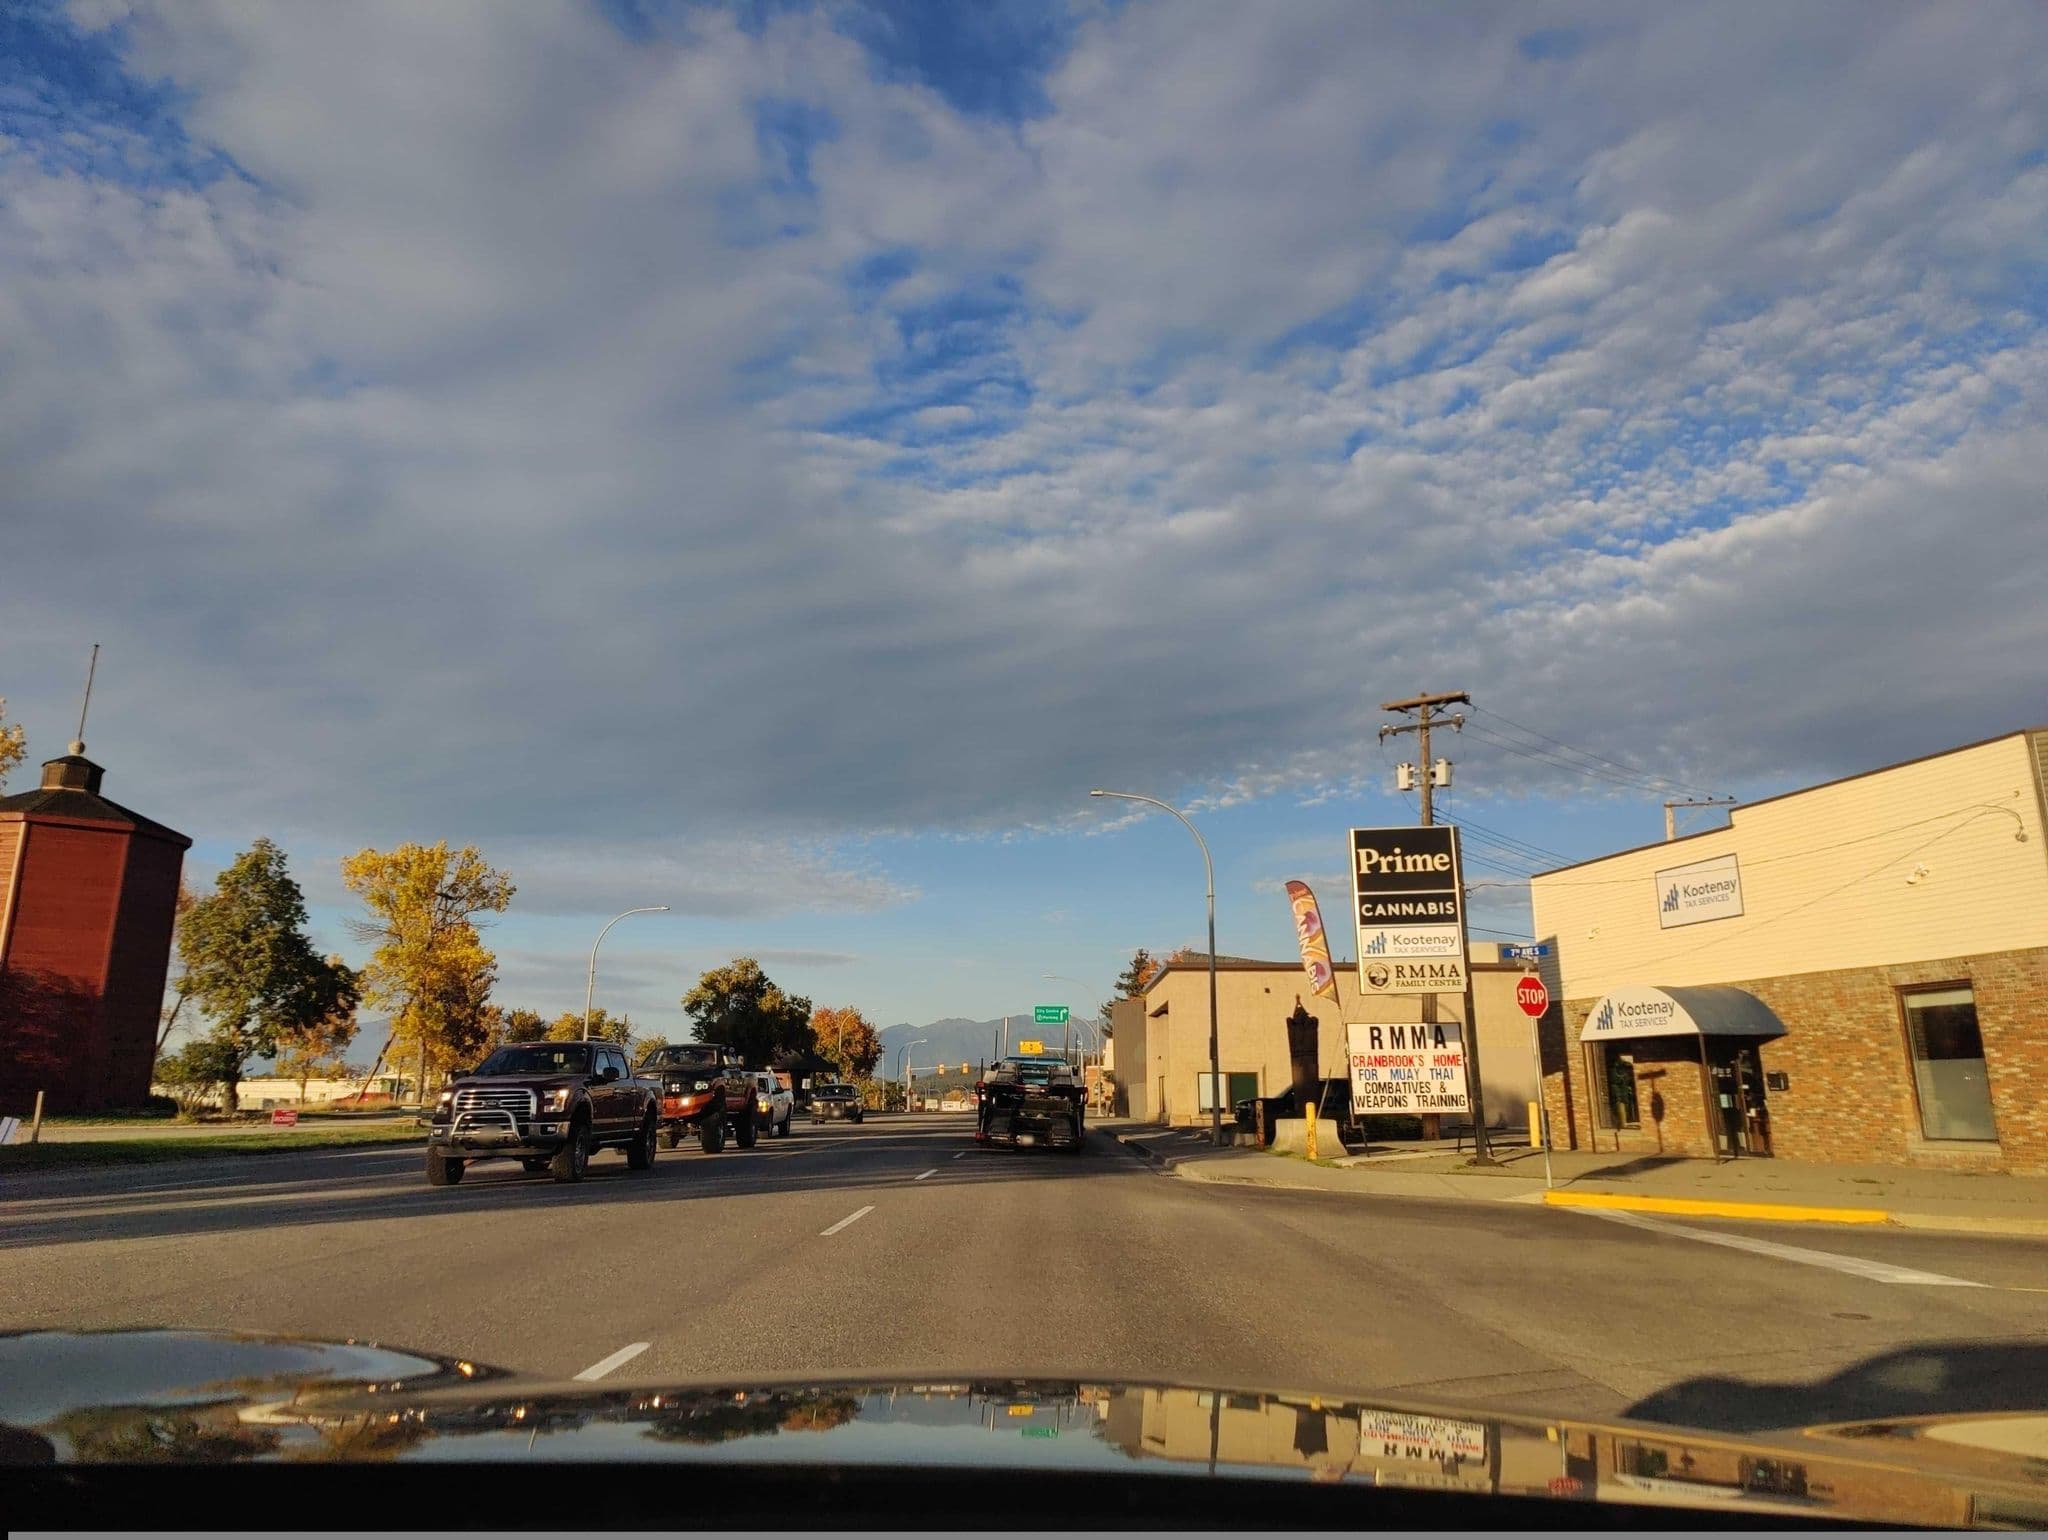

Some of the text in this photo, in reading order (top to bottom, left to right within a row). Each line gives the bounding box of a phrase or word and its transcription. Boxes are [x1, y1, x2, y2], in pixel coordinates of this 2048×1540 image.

[1357, 847, 1450, 874] Prime
[1682, 879, 1737, 898] Kootenay
[1684, 894, 1730, 908] TAX SERVICES
[1361, 901, 1455, 917] CANNABIS
[1292, 897, 1320, 995] CANNABIS
[1393, 934, 1456, 947] Kootenay
[1394, 945, 1447, 954] TAX SERVICES
[1395, 964, 1460, 979] RMMA
[1396, 978, 1462, 988] FAMILY CENTRE
[1518, 988, 1545, 1005] STOP
[1617, 1001, 1675, 1017] Kootenay
[1619, 1017, 1668, 1029] TAX SERVICES
[1369, 1026, 1447, 1050] RMMA
[1352, 1054, 1462, 1067] CRANBROOK'S HOME
[1358, 1067, 1454, 1081] FOR MUAY THAI
[1364, 1080, 1447, 1094] COMBATIVES &
[1354, 1094, 1466, 1108] WEAPONS TRAINING
